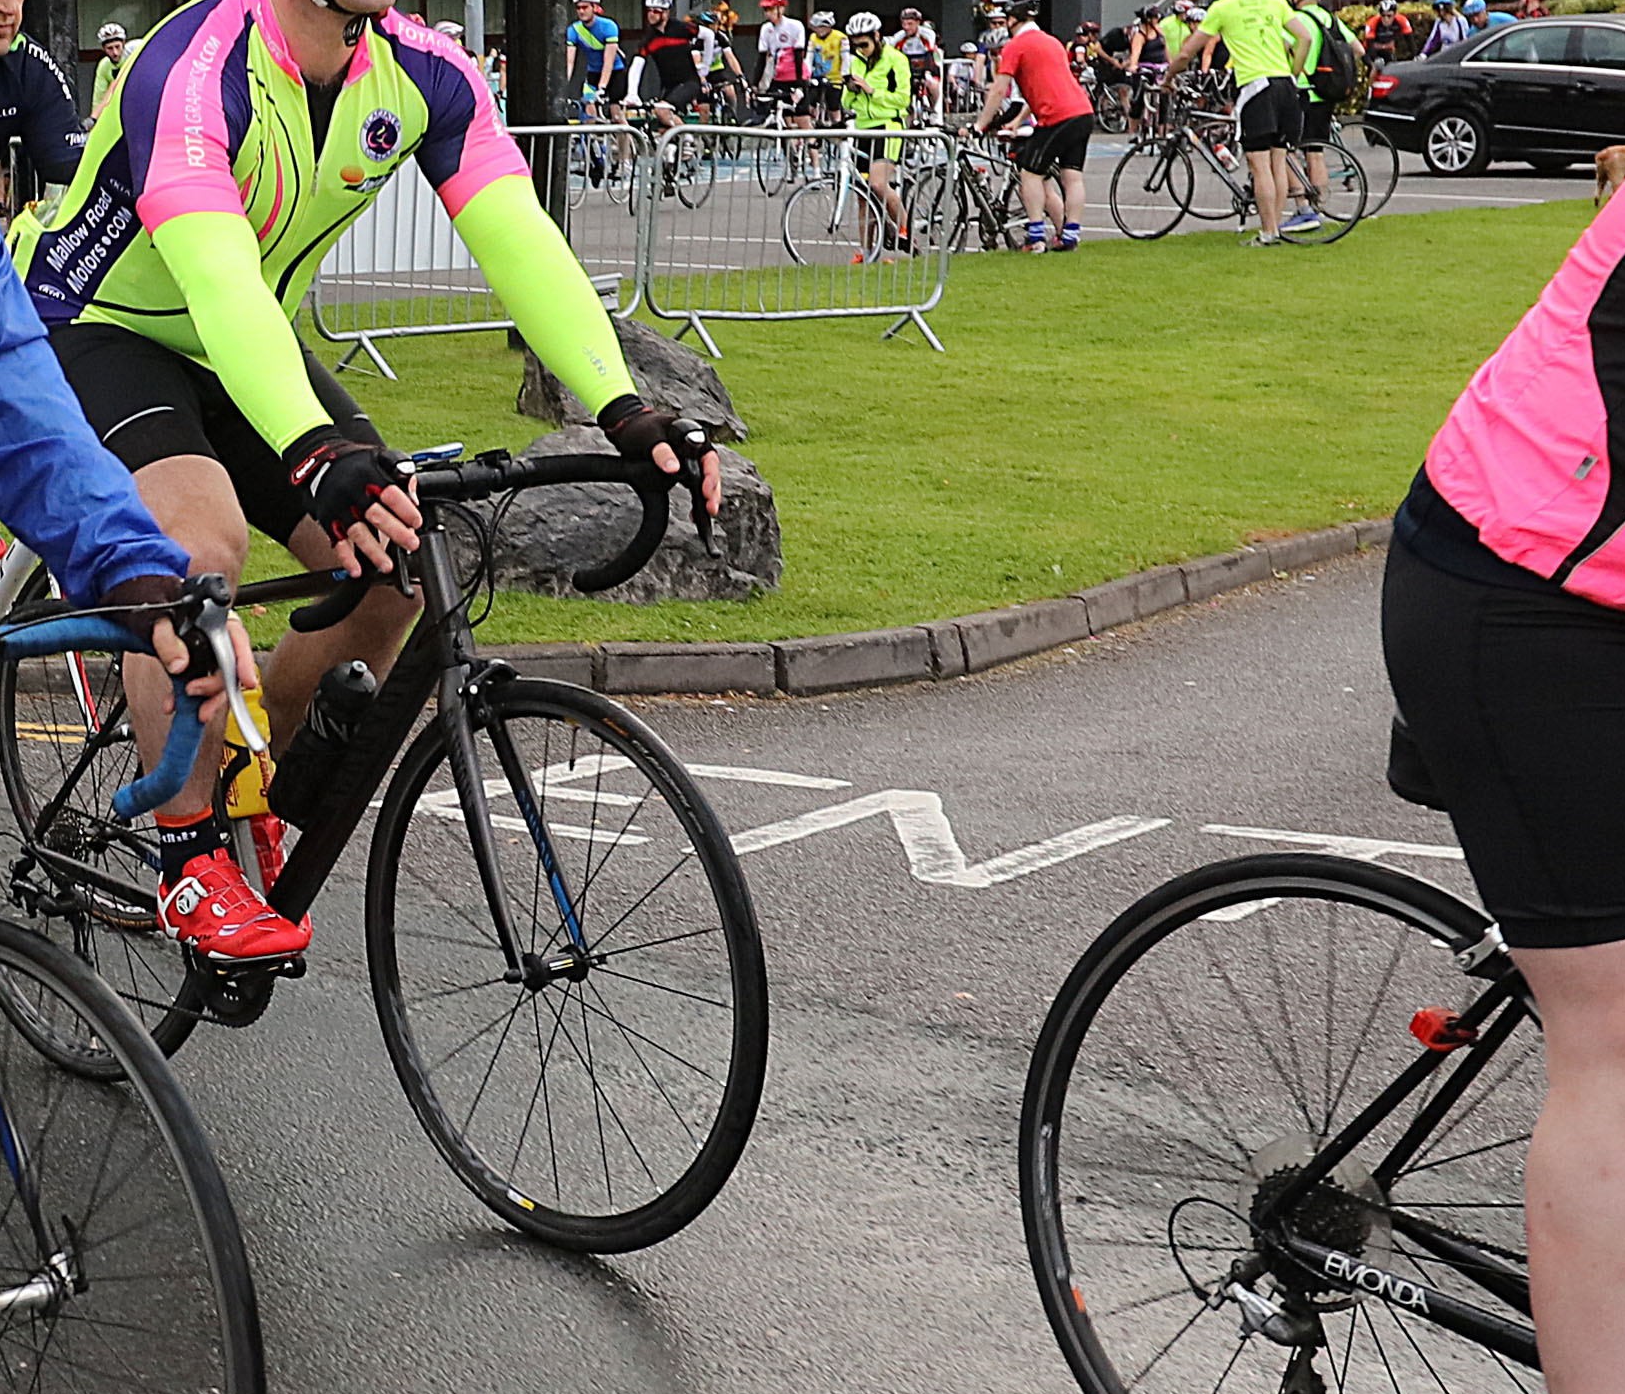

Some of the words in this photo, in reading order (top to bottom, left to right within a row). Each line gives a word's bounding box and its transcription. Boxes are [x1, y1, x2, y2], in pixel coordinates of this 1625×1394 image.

[399, 20, 436, 47] FOTA
[184, 125, 207, 168] FOTA
[46, 226, 90, 274] Mallow
[85, 187, 113, 232] Road
